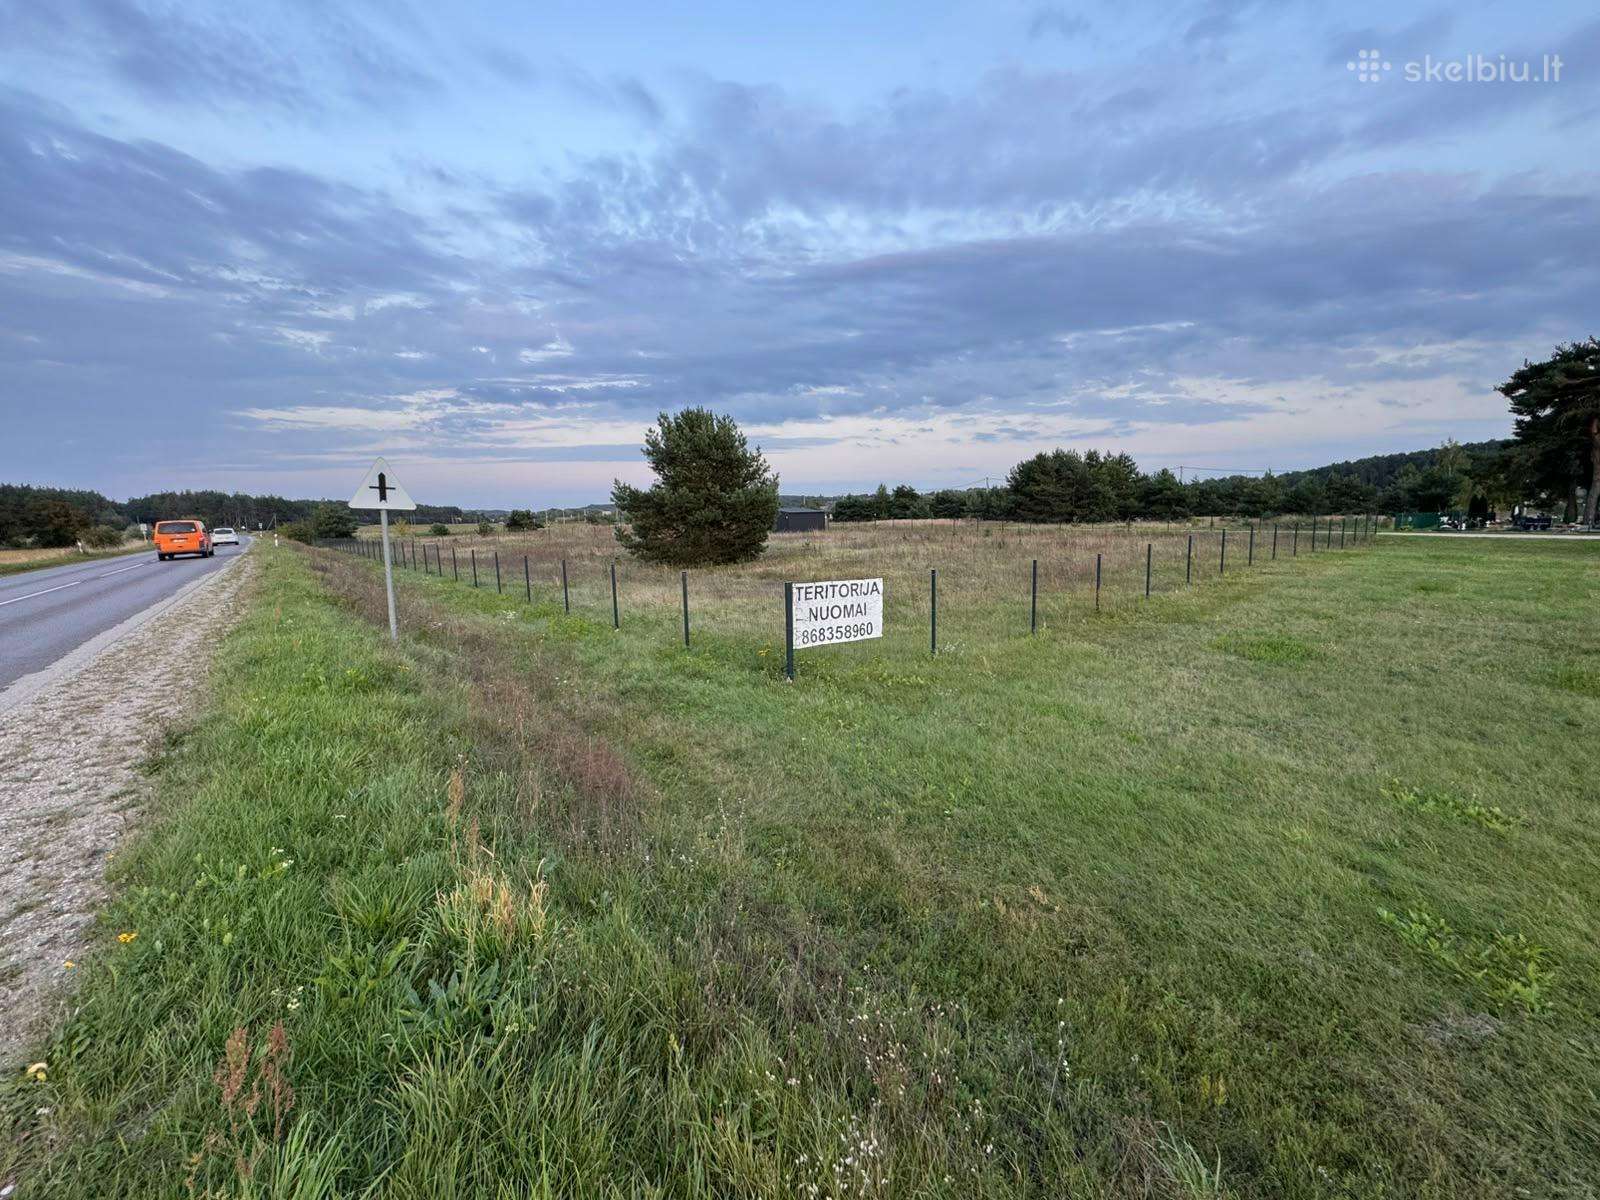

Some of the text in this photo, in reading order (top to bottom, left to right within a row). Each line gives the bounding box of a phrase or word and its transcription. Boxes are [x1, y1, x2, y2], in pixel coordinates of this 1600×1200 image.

[796, 581, 880, 601] TERITORIJA
[809, 602, 867, 622] NUOMAI
[802, 621, 873, 644] 868358960
